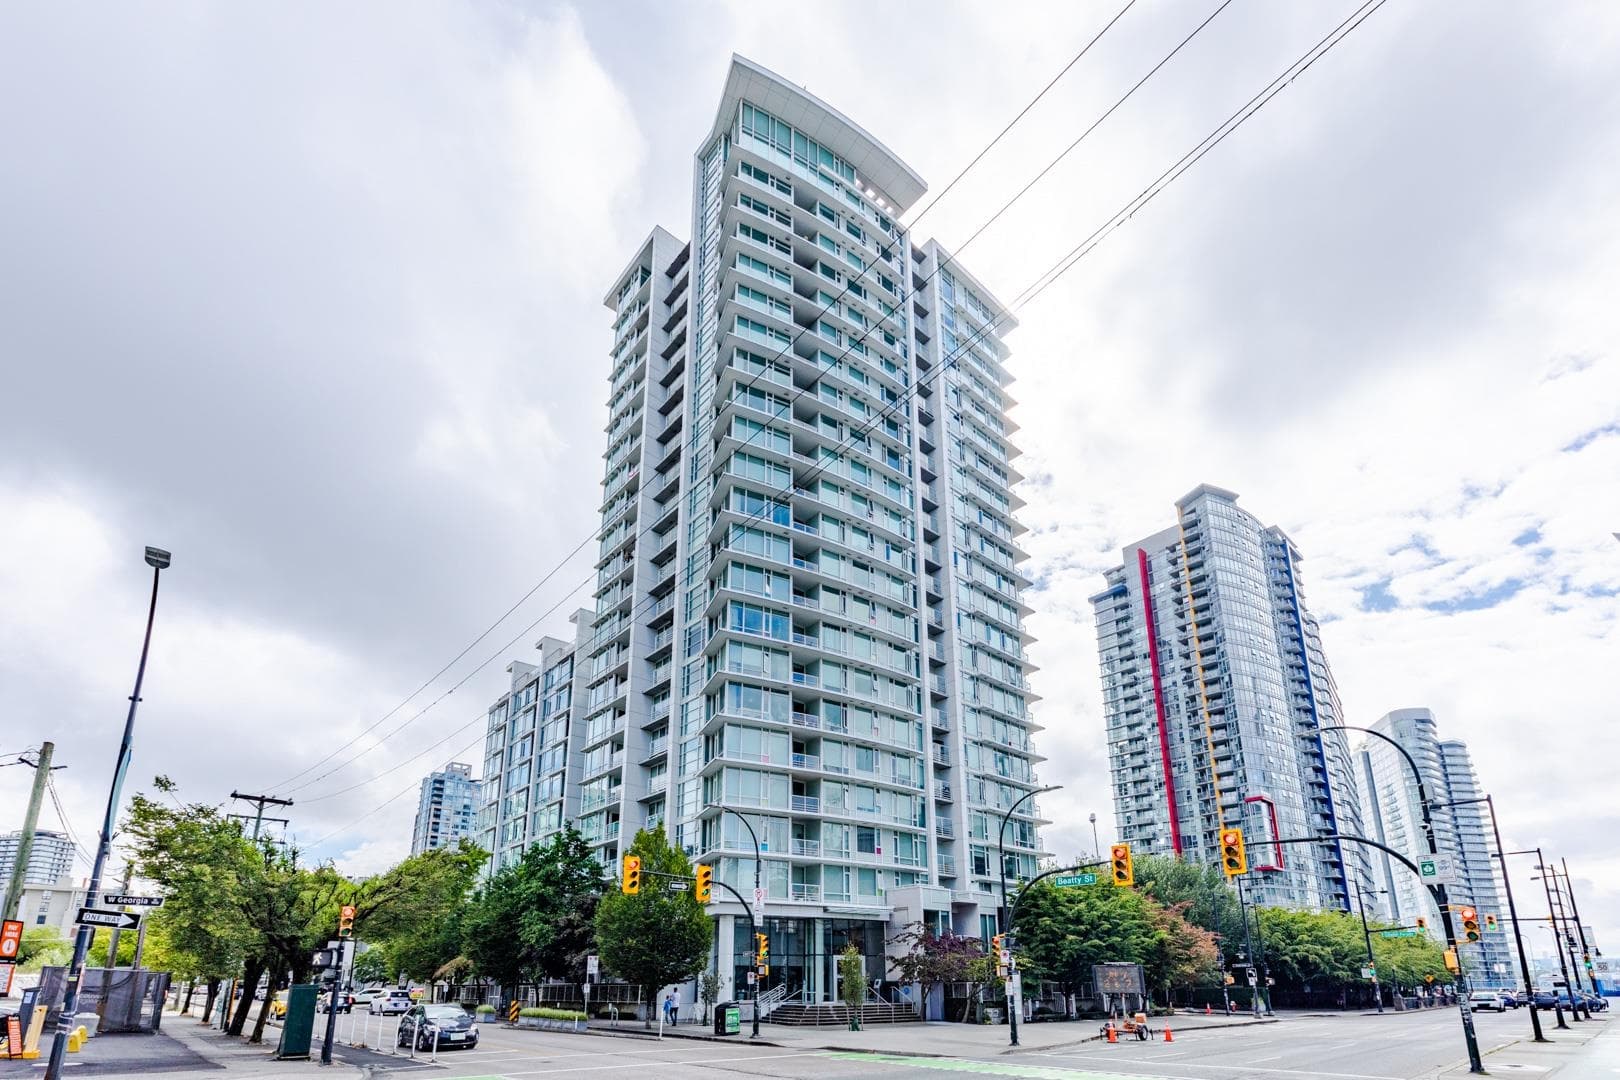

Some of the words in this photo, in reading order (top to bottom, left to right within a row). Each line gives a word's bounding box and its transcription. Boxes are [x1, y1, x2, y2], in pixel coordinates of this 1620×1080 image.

[1084, 875, 1093, 883] St
[117, 896, 149, 905] Georgia
[85, 912, 101, 921] ONE
[104, 914, 121, 923] WAY
